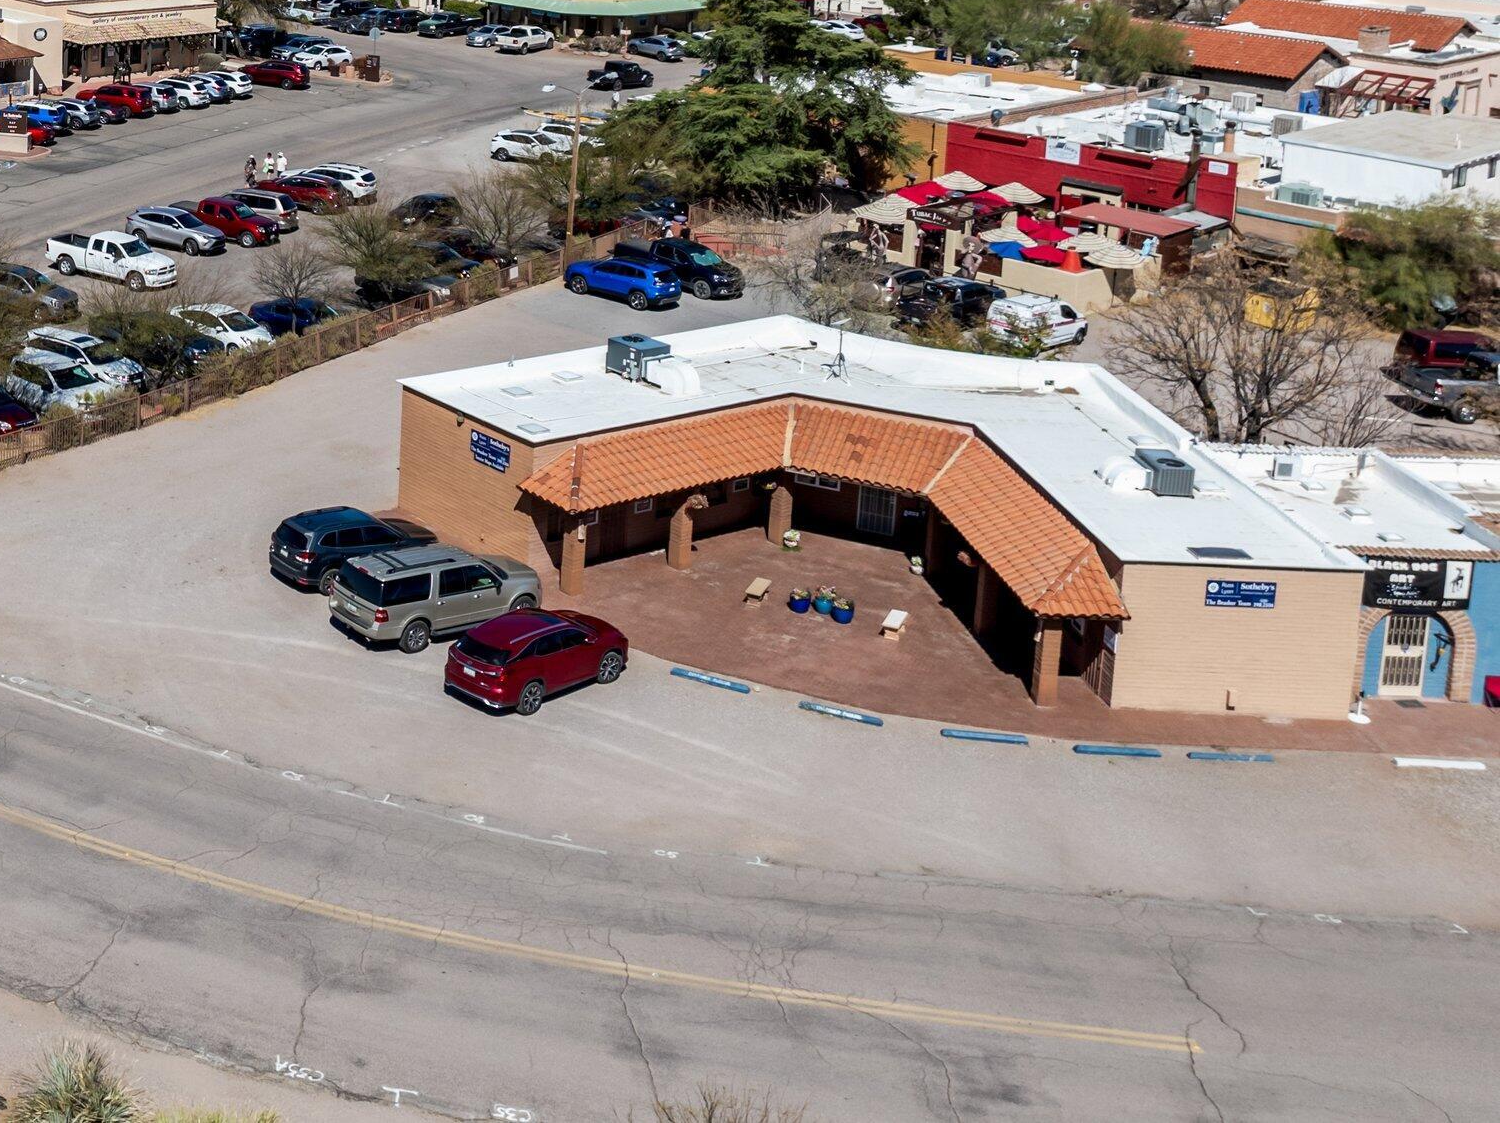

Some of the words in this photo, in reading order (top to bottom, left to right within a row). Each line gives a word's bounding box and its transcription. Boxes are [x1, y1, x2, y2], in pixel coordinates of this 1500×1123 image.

[117, 14, 150, 22] contemporary
[165, 11, 183, 19] jewelry
[1368, 560, 1409, 571] BLACK
[1411, 562, 1438, 572] DOG
[1389, 574, 1416, 583] ART
[1240, 582, 1276, 593] Sotheby's
[1237, 599, 1252, 607] Team
[1377, 598, 1438, 607] CONTEMPORARY
